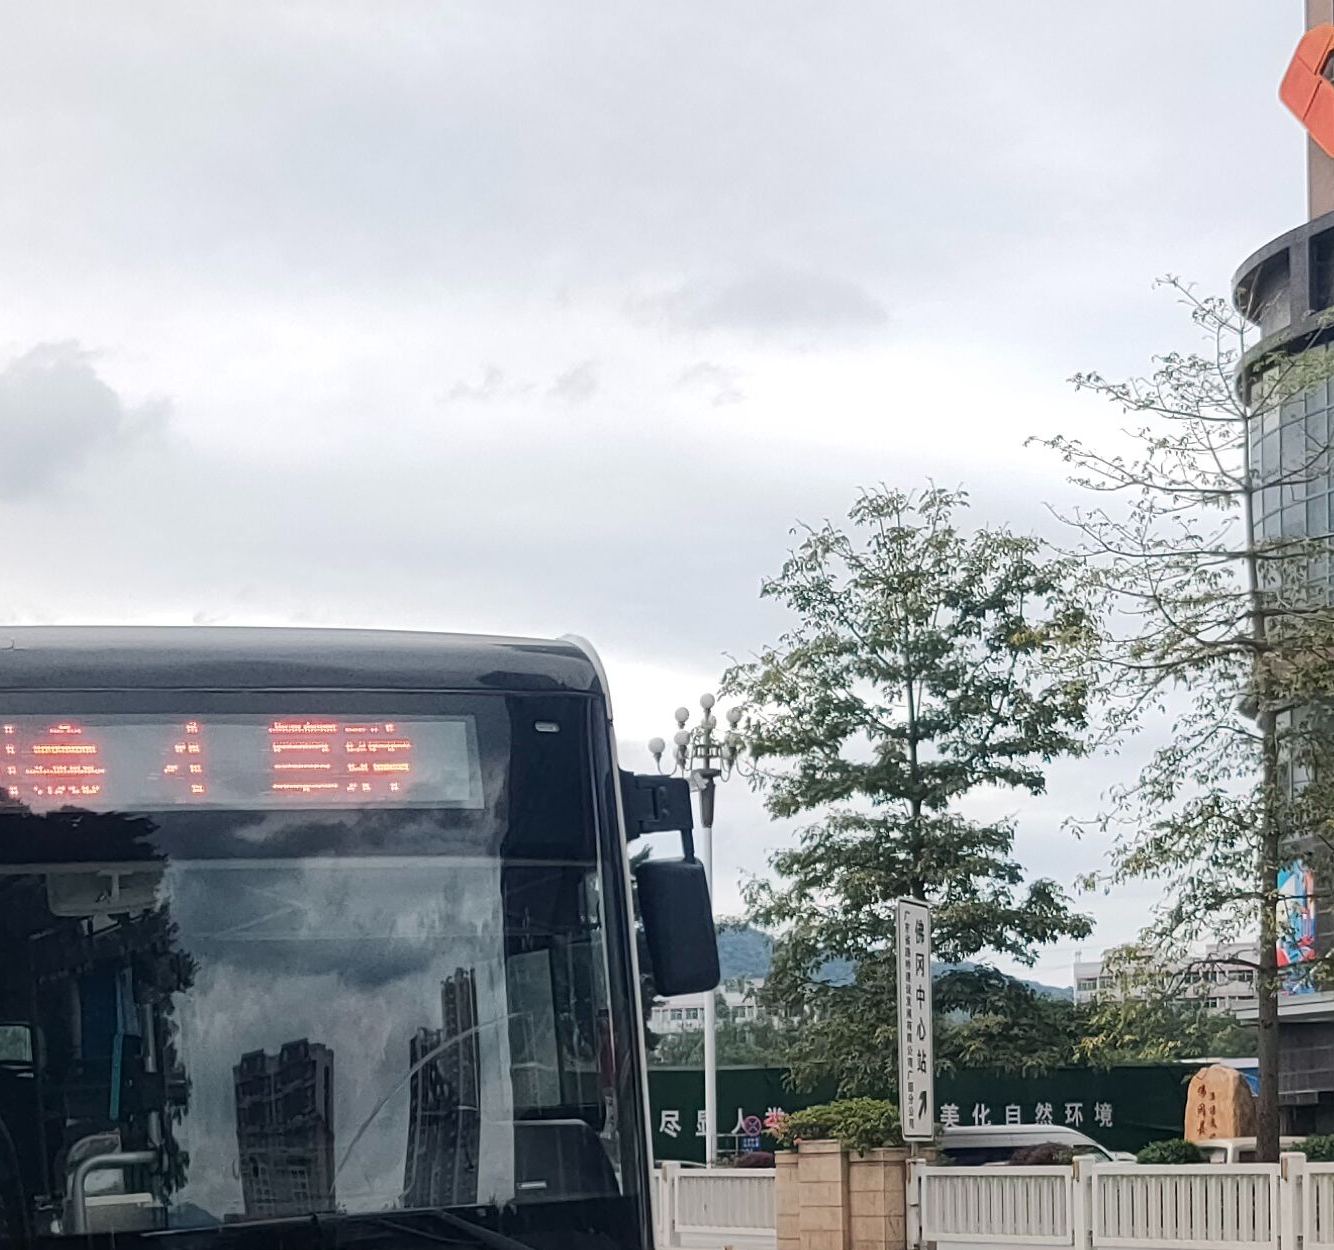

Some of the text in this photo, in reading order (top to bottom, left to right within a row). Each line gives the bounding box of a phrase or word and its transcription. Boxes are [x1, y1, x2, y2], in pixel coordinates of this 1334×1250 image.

[915, 919, 927, 1075] 佛冈中心站
[940, 1102, 1114, 1128] 美化自然环境
